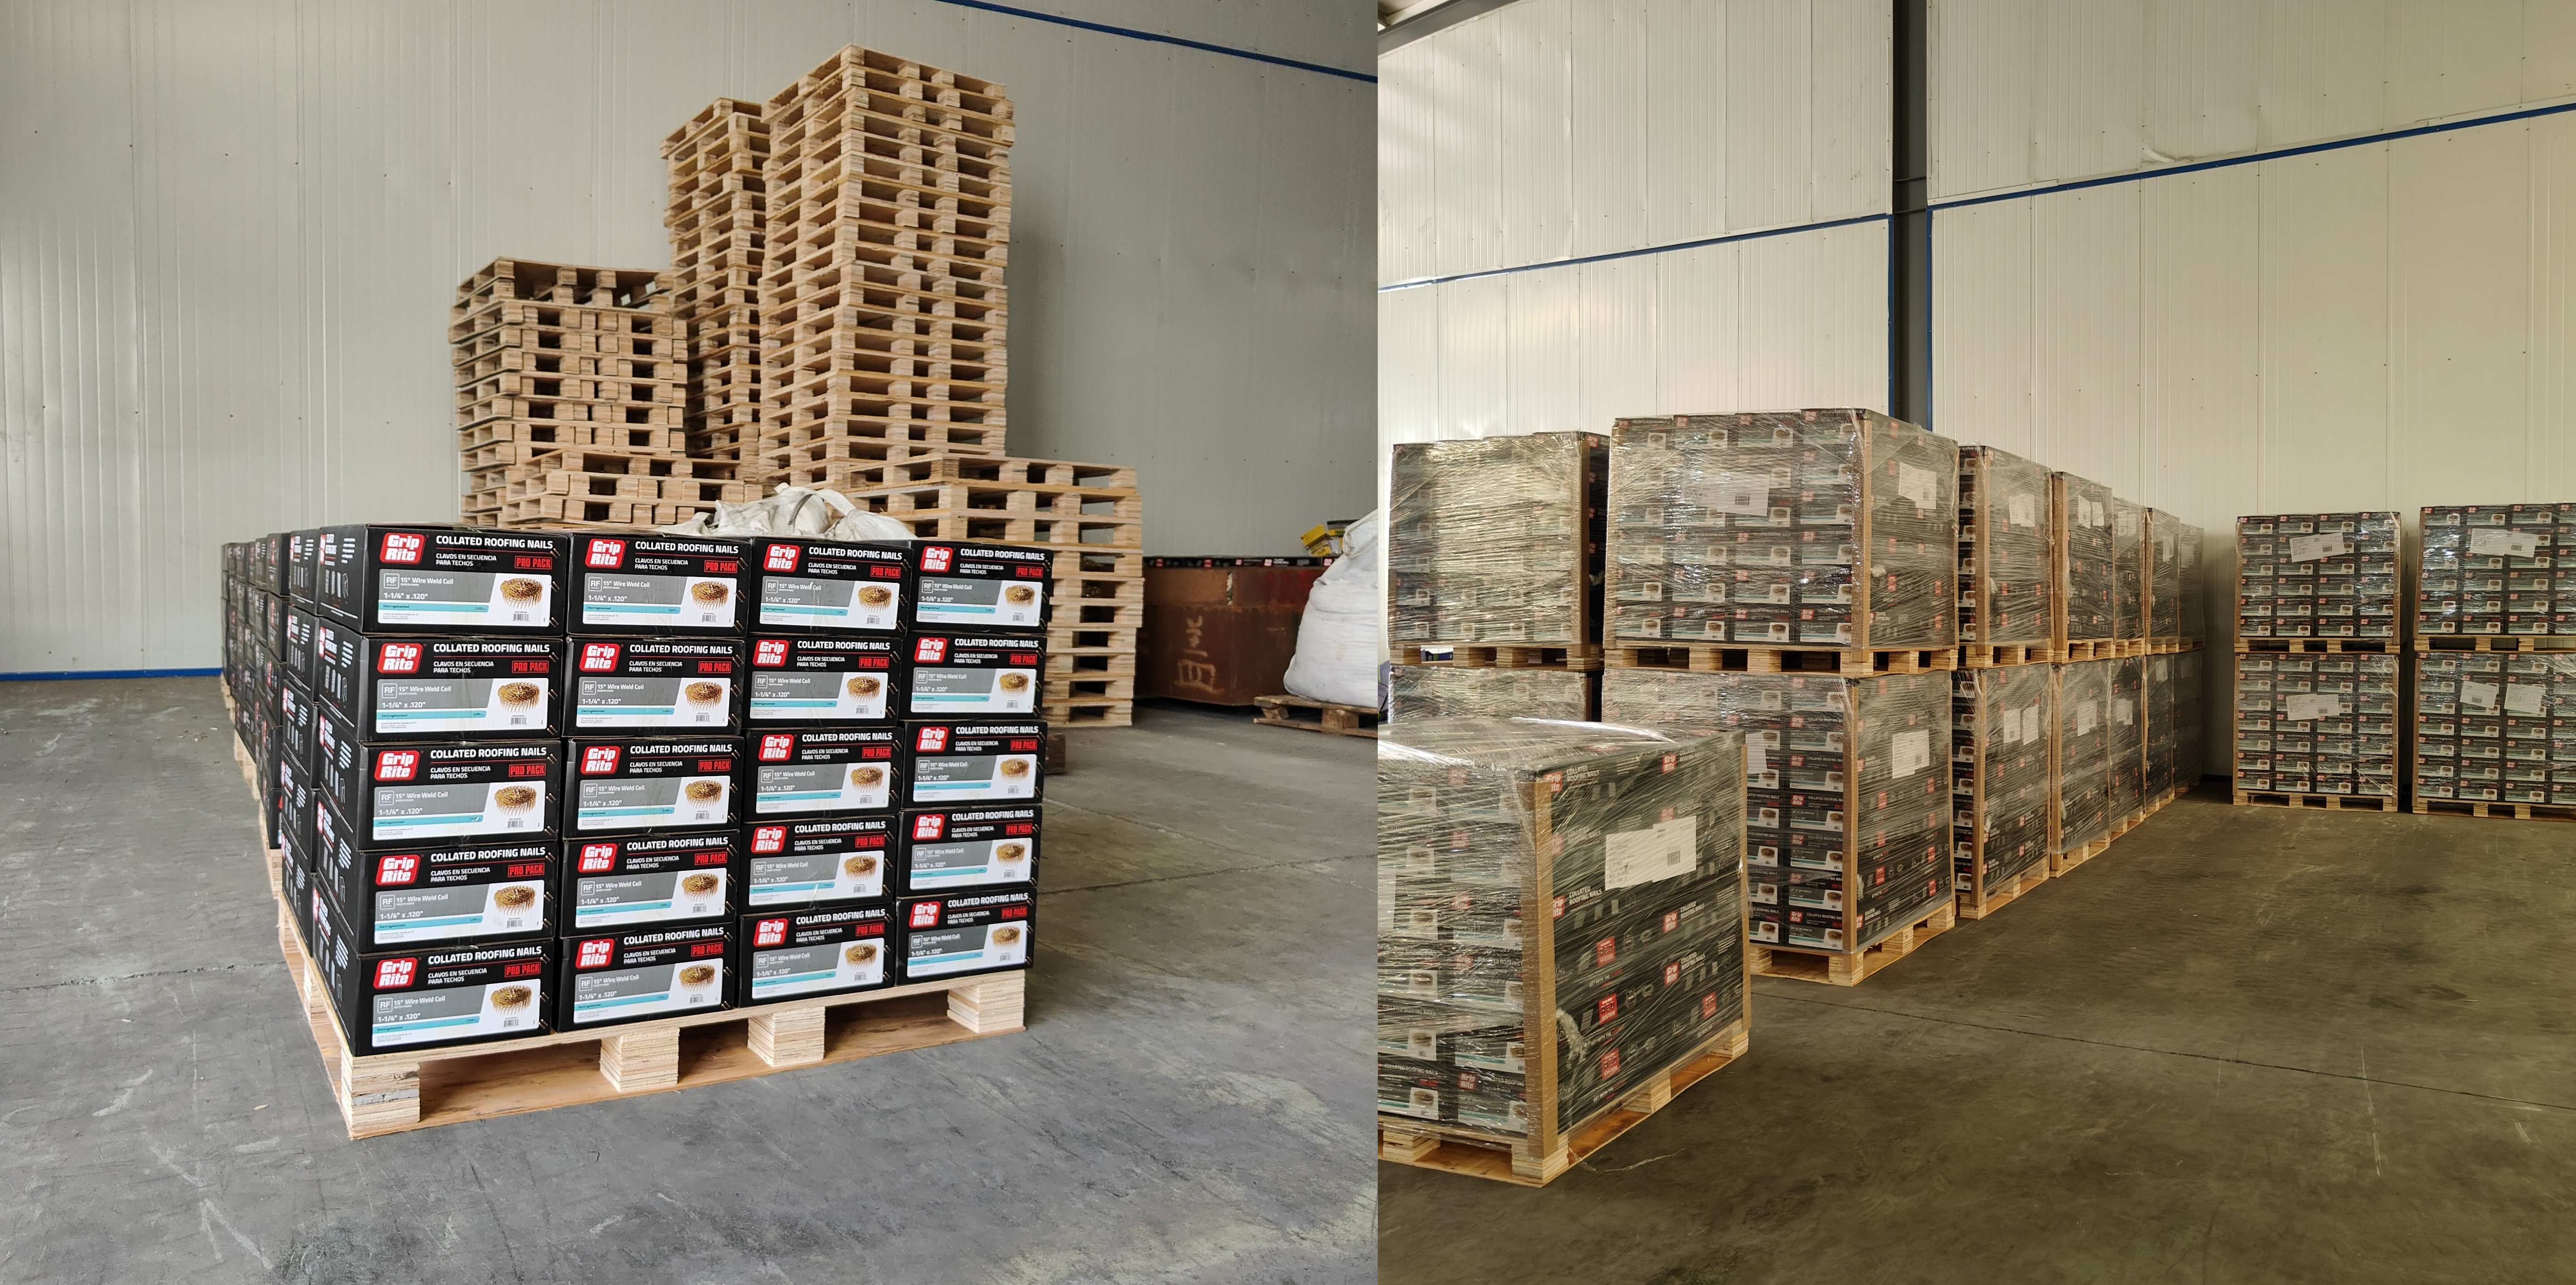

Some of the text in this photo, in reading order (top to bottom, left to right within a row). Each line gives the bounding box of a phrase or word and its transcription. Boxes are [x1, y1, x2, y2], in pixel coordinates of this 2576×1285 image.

[387, 535, 420, 549] Grip
[436, 535, 553, 549] COLLATED ROOFING NAILS
[592, 541, 620, 554] Grip
[385, 546, 417, 561] Rite
[770, 546, 796, 558] Grip
[926, 548, 949, 560] Grip
[961, 548, 994, 557] COLLATED
[995, 551, 1025, 559] ROOFING
[516, 558, 551, 568] PRO PACK
[590, 552, 618, 565] Rite
[768, 556, 793, 569] Rite
[924, 558, 947, 569] Rite
[759, 642, 784, 654] Grip
[920, 639, 943, 650] Grip
[385, 645, 417, 659] Grip
[586, 645, 615, 658] Grip
[757, 651, 782, 664] Rite
[919, 648, 941, 660] Rite
[383, 655, 414, 670] Rite
[584, 655, 612, 669] Rite
[922, 728, 945, 739] Grip
[765, 736, 789, 748] Grip
[920, 737, 942, 749] Rite
[587, 748, 616, 760] Grip
[763, 745, 787, 758] Rite
[863, 748, 890, 757] PRO PACK
[382, 753, 414, 766] Grip
[586, 757, 613, 772] Rite
[380, 762, 411, 778] Rite
[1567, 766, 1588, 775] COLLATED
[1567, 773, 1586, 782] ROOFING
[918, 816, 941, 827] Grip
[757, 828, 782, 840] Grip
[916, 824, 939, 837] Rite
[755, 837, 780, 851] Rite
[585, 845, 613, 858] Grip
[383, 857, 415, 870] Grip
[582, 855, 610, 870] Rite
[381, 867, 411, 883] Rite
[1569, 886, 1590, 898] COLLATED
[1570, 889, 1602, 905] ROOFING NAILS
[914, 903, 937, 915] Grip
[1680, 902, 1696, 913] COLLATED
[1681, 903, 1704, 919] ROOFING NAILS
[913, 911, 935, 925] Rite
[1666, 913, 1676, 923] Grip
[759, 921, 784, 933] Grip
[1666, 921, 1675, 931] Rite
[624, 927, 724, 945] COLLATED ROOFING NAILS
[758, 929, 782, 944] Rite
[582, 941, 610, 954] Grip
[649, 947, 676, 956] SECUENCIA
[692, 944, 722, 954] PRO PACK
[580, 950, 607, 966] Rite
[1600, 954, 1613, 963] SYSTEM
[1681, 952, 1697, 964] COLLATED
[1682, 954, 1705, 969] ROOFING NAILS
[381, 960, 412, 974] Grip
[1667, 964, 1677, 974] Grip
[379, 969, 409, 986] Rite
[1667, 973, 1676, 983] Rite
[1601, 1011, 1615, 1021] SYSTEM
[1461, 1073, 1475, 1082] Grip
